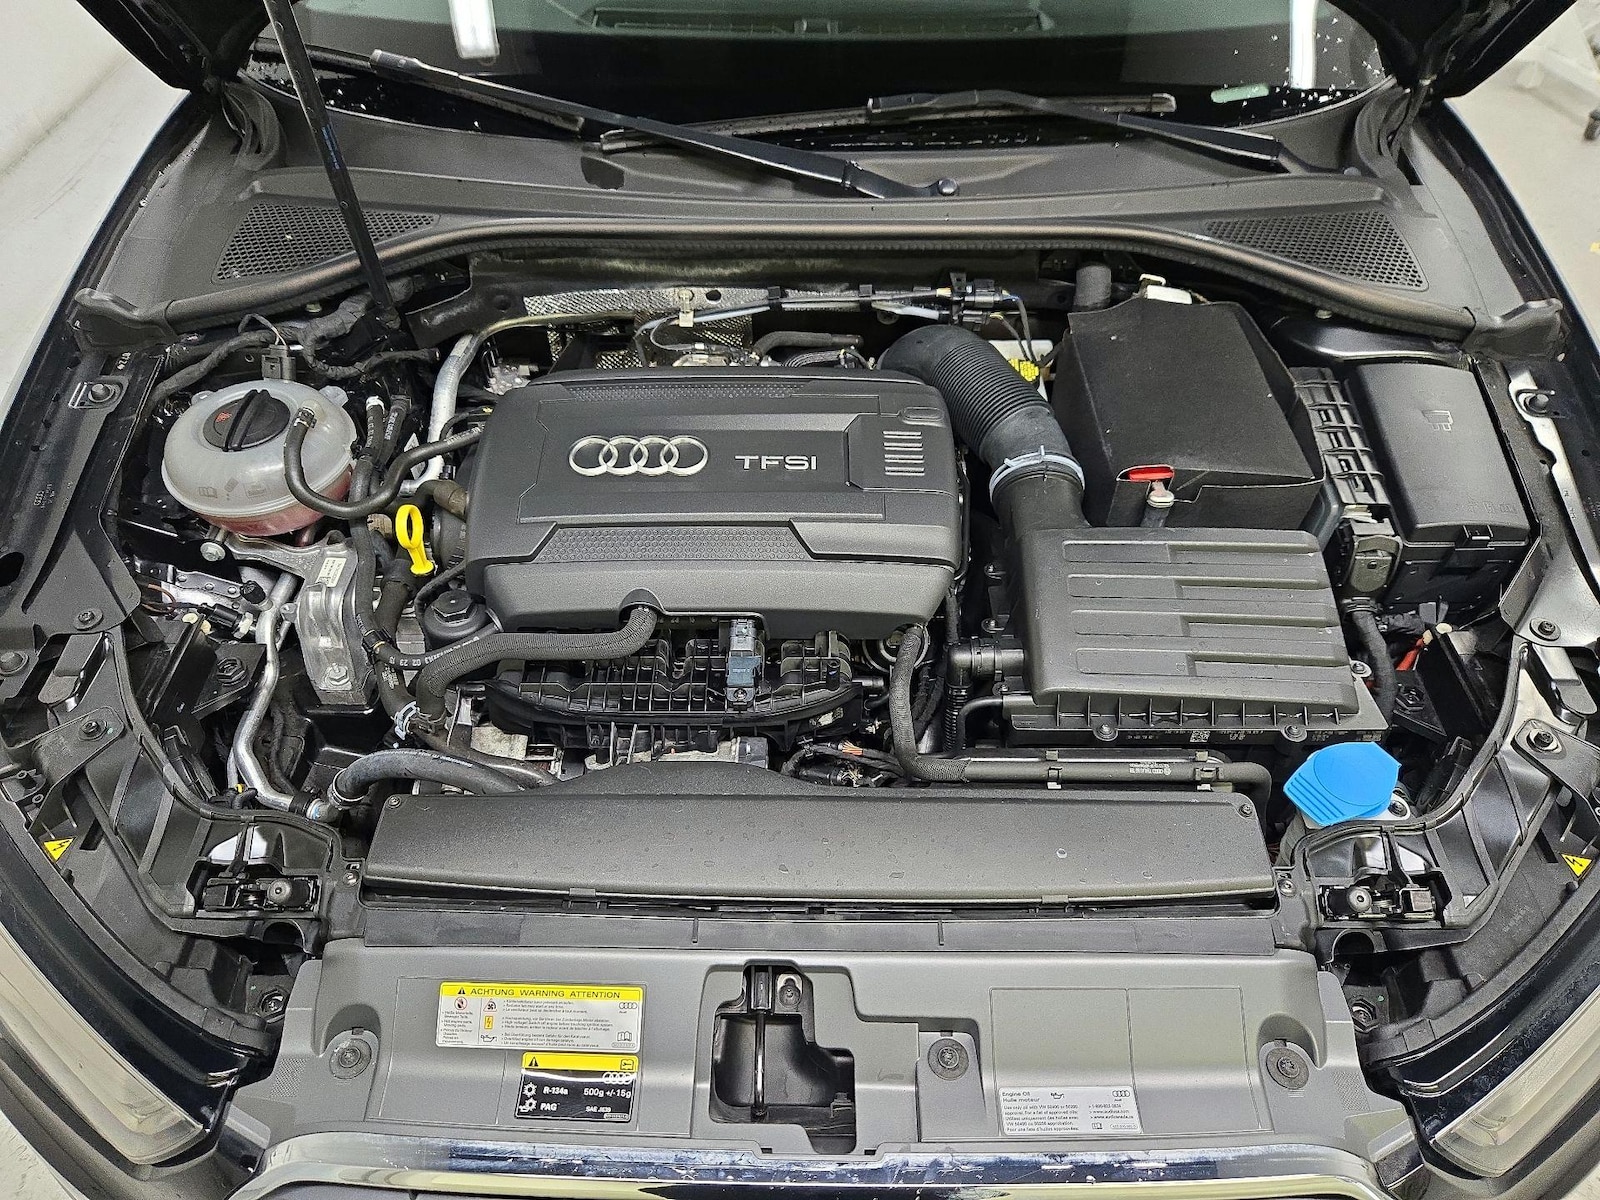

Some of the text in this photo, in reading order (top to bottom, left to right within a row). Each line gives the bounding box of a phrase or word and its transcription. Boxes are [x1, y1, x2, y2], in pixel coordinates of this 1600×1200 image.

[735, 455, 817, 470] TFSI
[470, 988, 621, 999] ACHTUNG WARNING ATTENTION
[543, 1086, 569, 1095] R-134a
[583, 1087, 604, 1097] 500g
[540, 1103, 557, 1111] PAG
